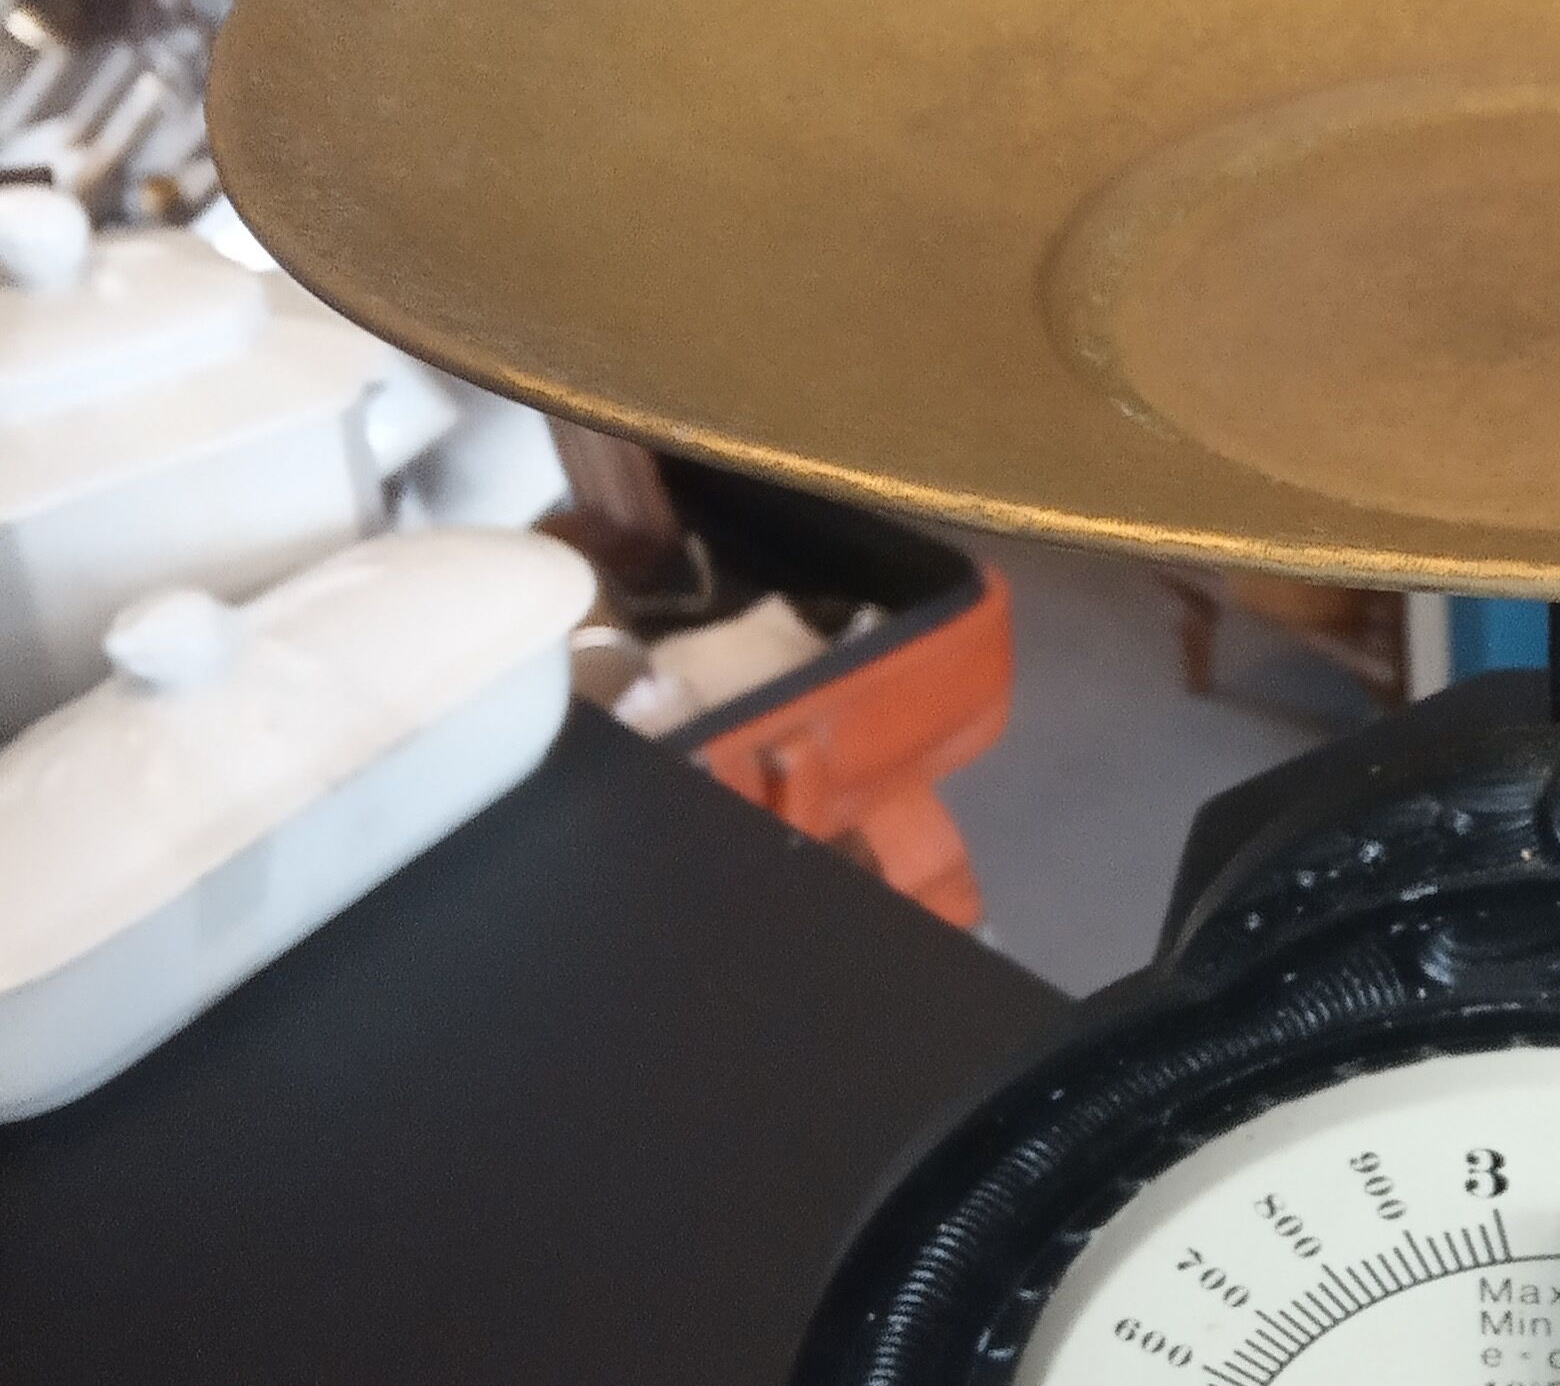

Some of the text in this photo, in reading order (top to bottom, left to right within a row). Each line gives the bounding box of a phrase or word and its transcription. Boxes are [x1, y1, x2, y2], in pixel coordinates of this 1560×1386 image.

[1347, 1150, 1408, 1223] 900
[1462, 1146, 1511, 1200] 3
[1254, 1192, 1323, 1260] 800
[1174, 1246, 1251, 1310] 700
[1112, 1316, 1195, 1369] 600
[1479, 1309, 1553, 1337] Min
[1480, 1346, 1503, 1368] e
